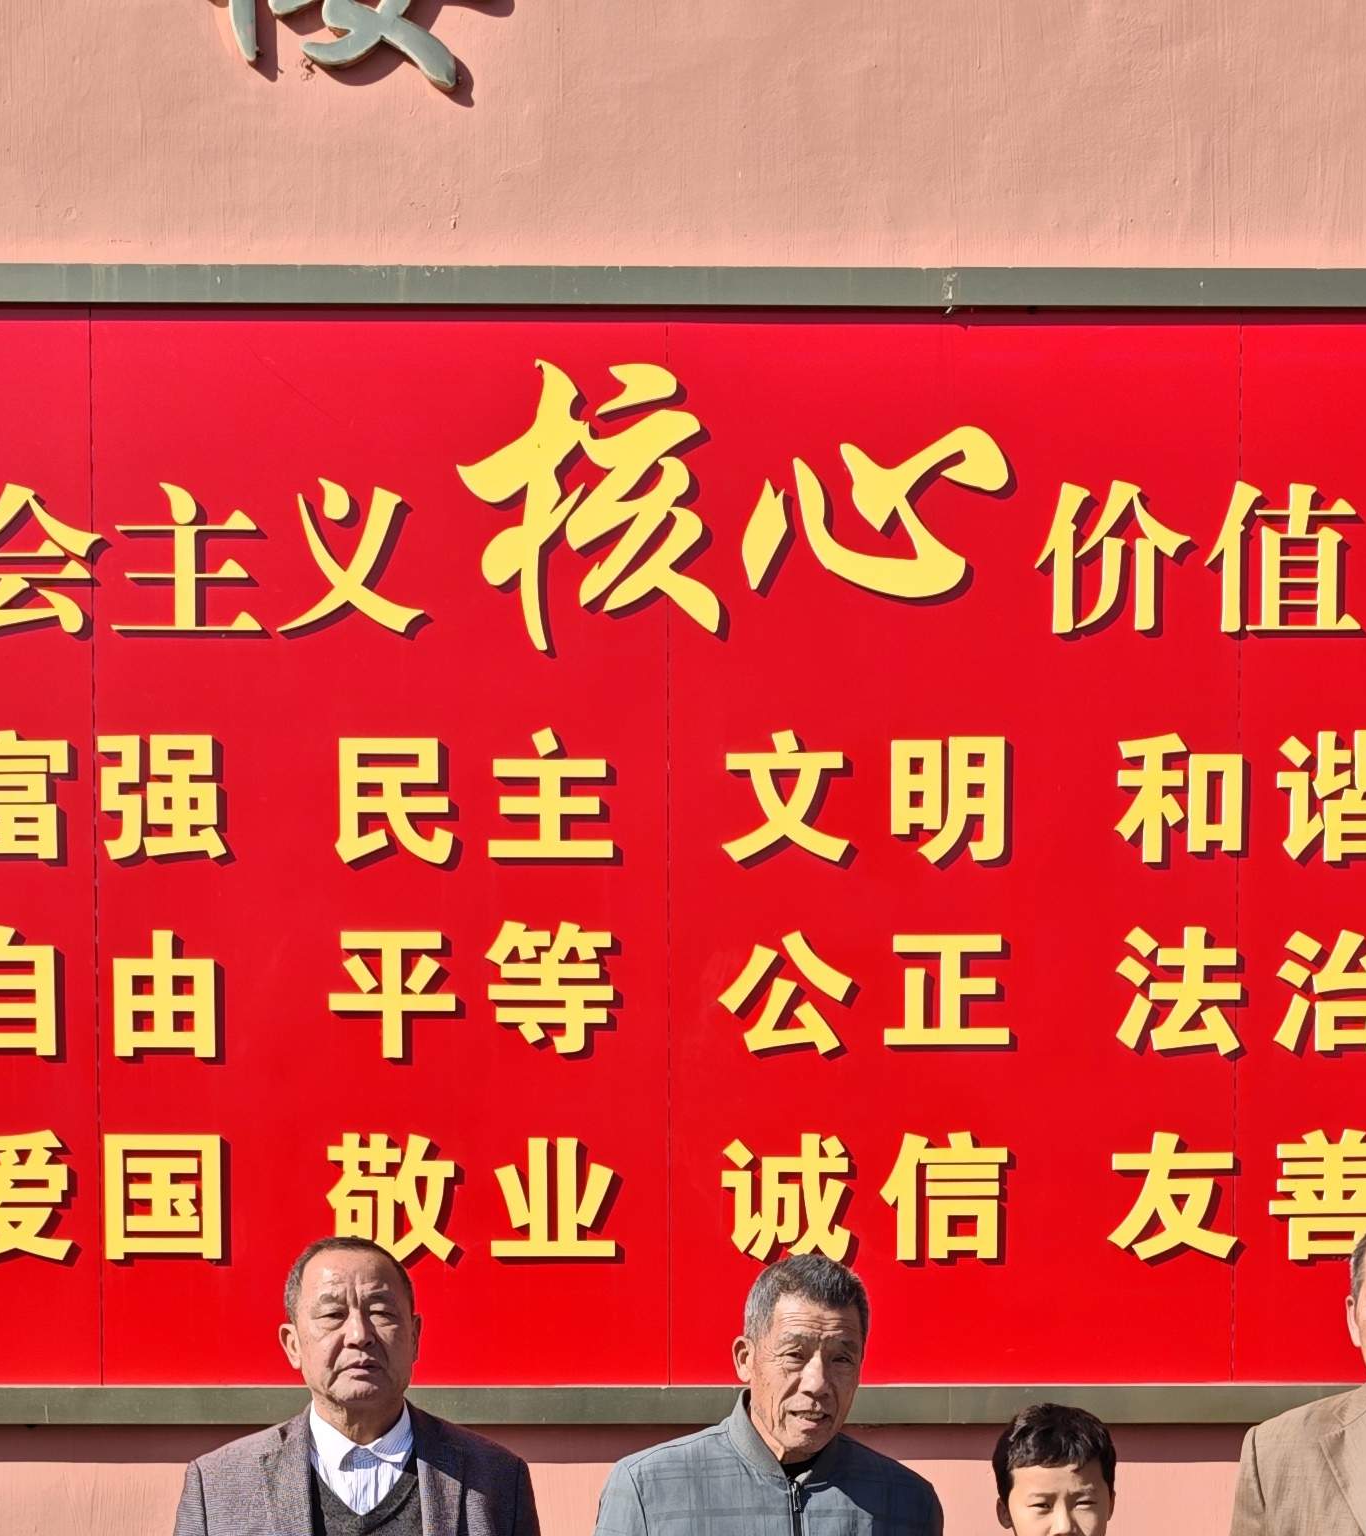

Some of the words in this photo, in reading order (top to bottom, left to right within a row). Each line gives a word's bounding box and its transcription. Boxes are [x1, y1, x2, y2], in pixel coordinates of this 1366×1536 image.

[335, 728, 613, 864] 民主
[722, 730, 1005, 863] 文明
[329, 921, 613, 1058] 平等
[718, 932, 1009, 1054] 公正
[327, 1132, 615, 1262] 敬业
[722, 1132, 1007, 1262] 诚信
